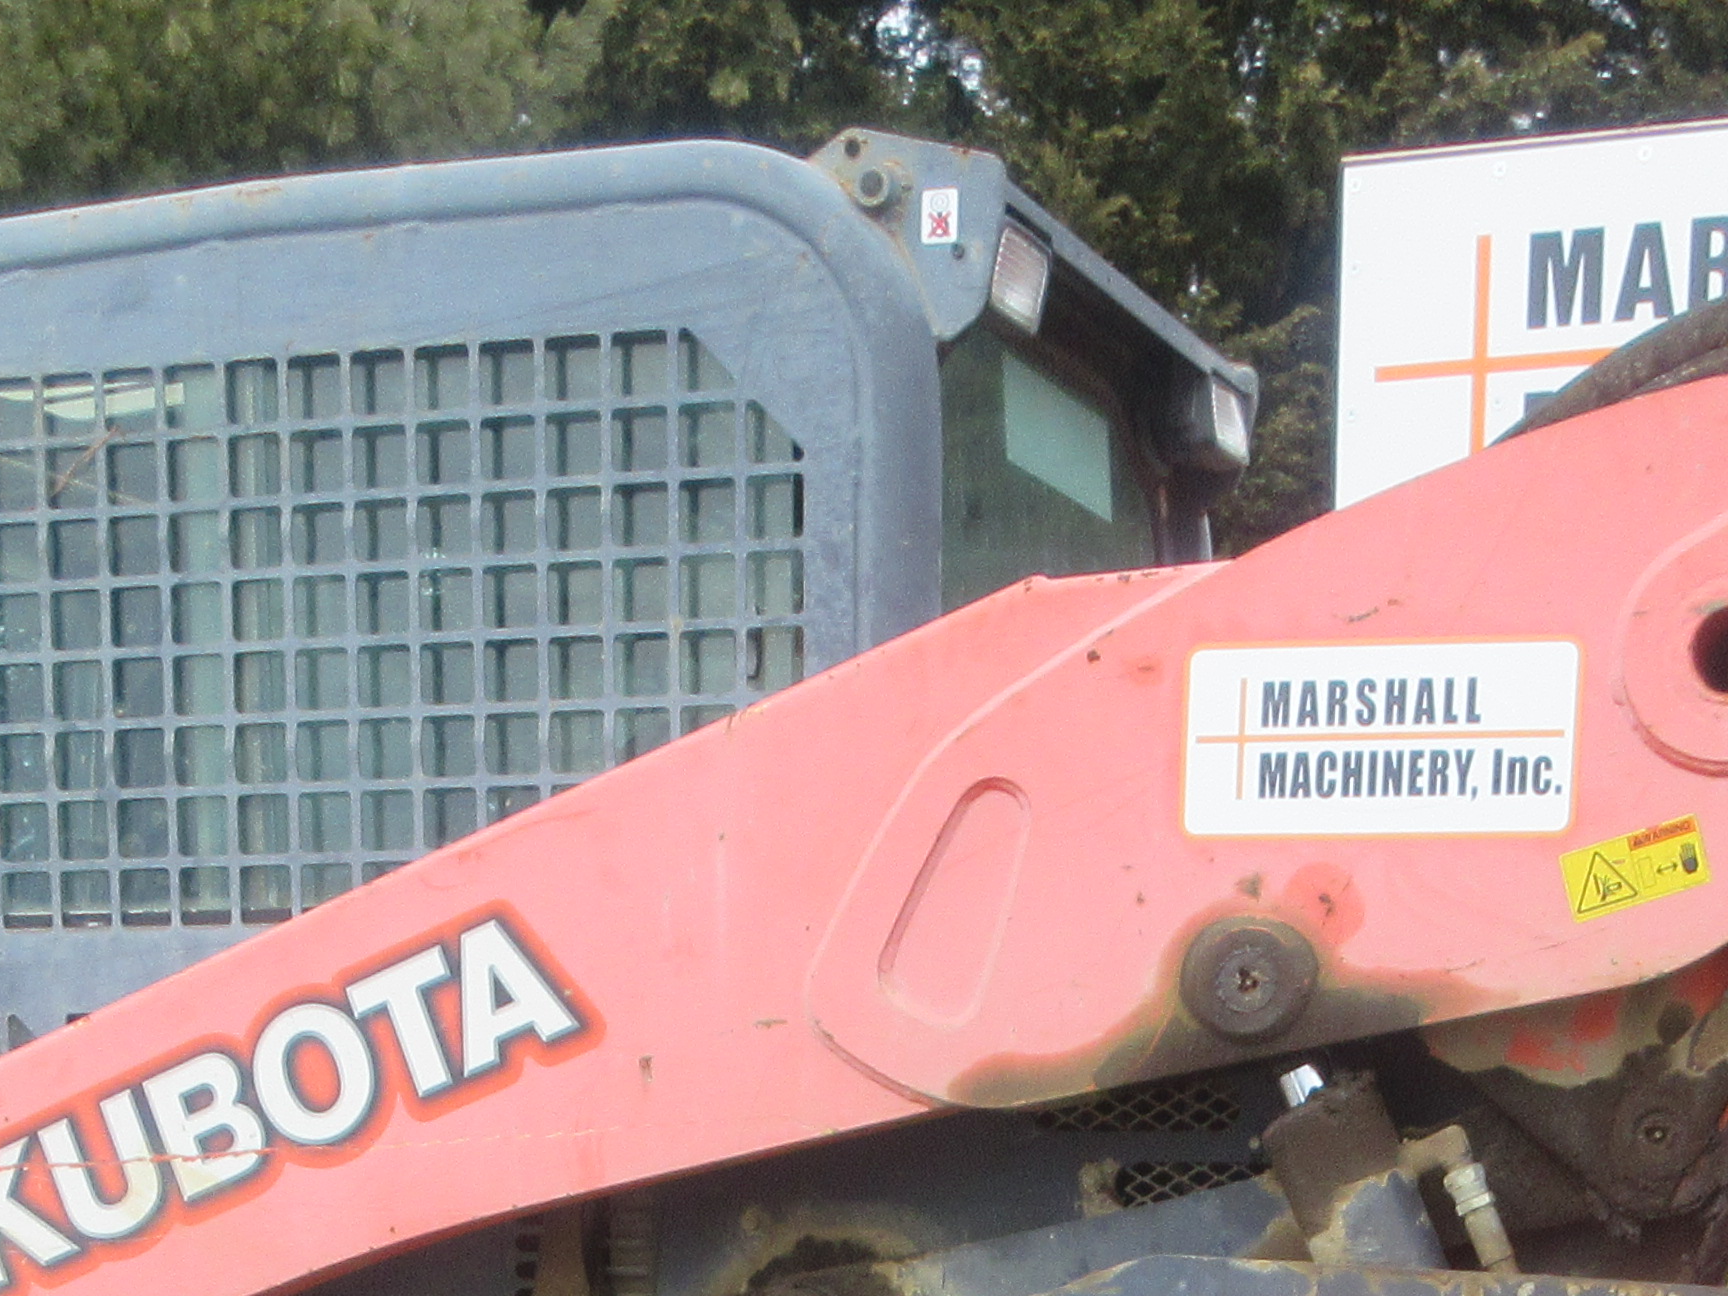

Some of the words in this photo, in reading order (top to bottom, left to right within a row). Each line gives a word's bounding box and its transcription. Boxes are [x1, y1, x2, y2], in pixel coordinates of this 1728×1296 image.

[1260, 677, 1482, 728] MARSHALL
[1258, 748, 1479, 801] MACHINERY,
[1490, 748, 1563, 796] Inc.
